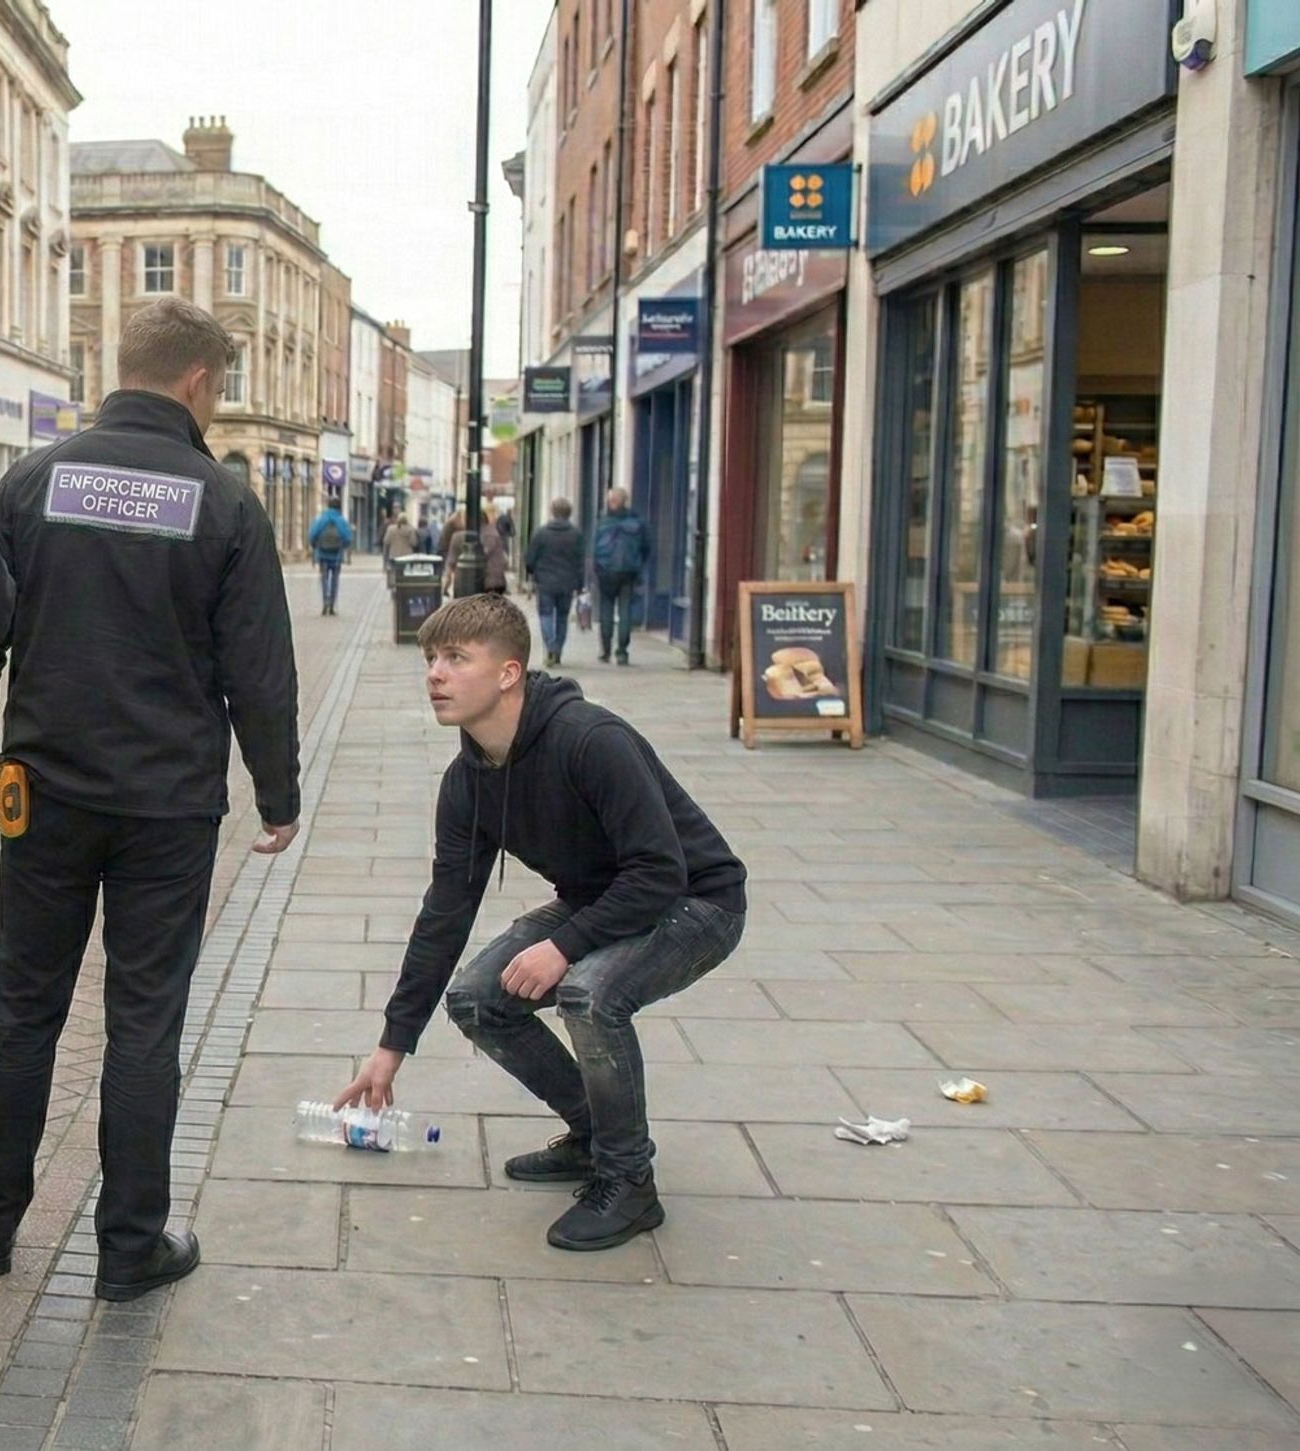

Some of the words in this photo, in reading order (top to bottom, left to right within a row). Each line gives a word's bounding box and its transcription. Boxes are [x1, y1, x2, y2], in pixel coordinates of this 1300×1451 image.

[941, 0, 1086, 177] BAKERY
[773, 225, 837, 240] BAKERY
[58, 473, 192, 504] ENFORCEMENT
[82, 494, 159, 519] OFFICER
